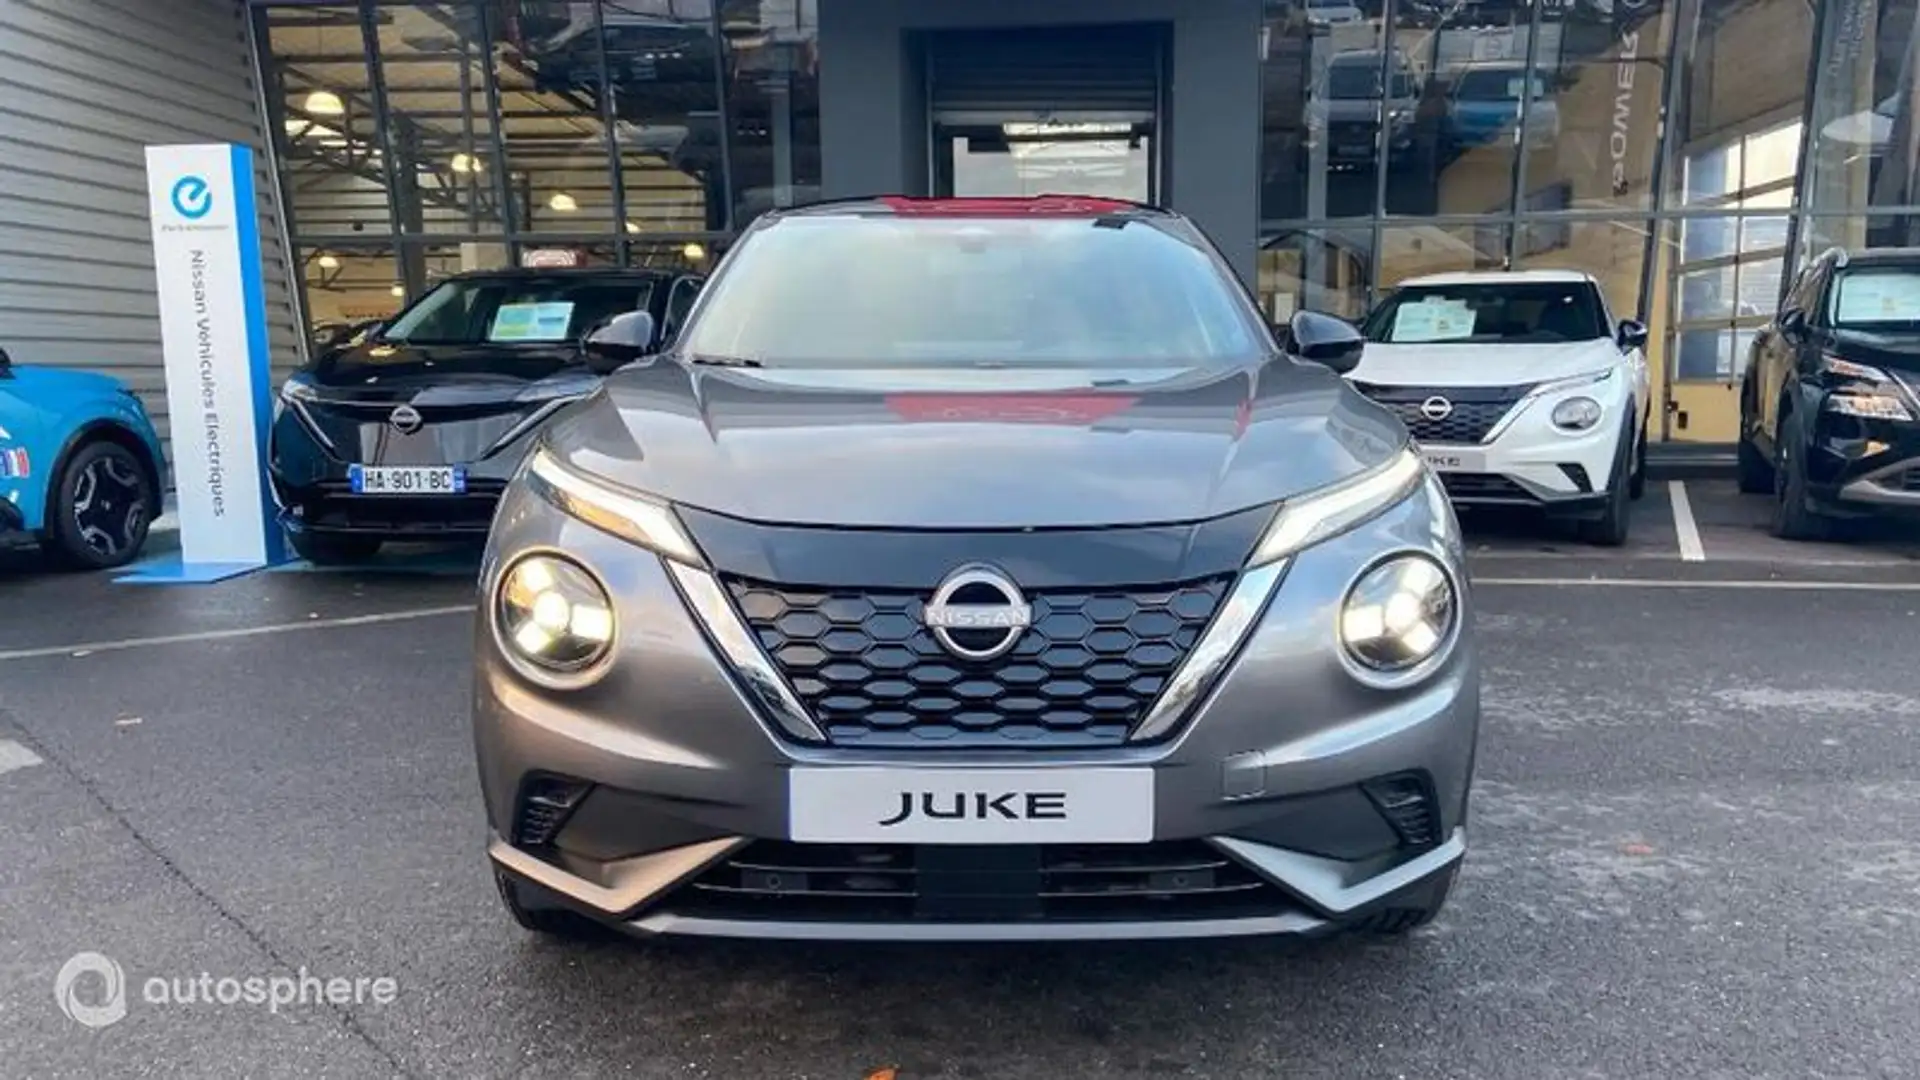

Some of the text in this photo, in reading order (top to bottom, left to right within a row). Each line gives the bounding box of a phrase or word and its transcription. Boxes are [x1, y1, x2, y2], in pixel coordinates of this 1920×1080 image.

[190, 249, 205, 314] Nissan
[928, 611, 1028, 625] NISSAN
[878, 792, 1067, 827] JUKE
